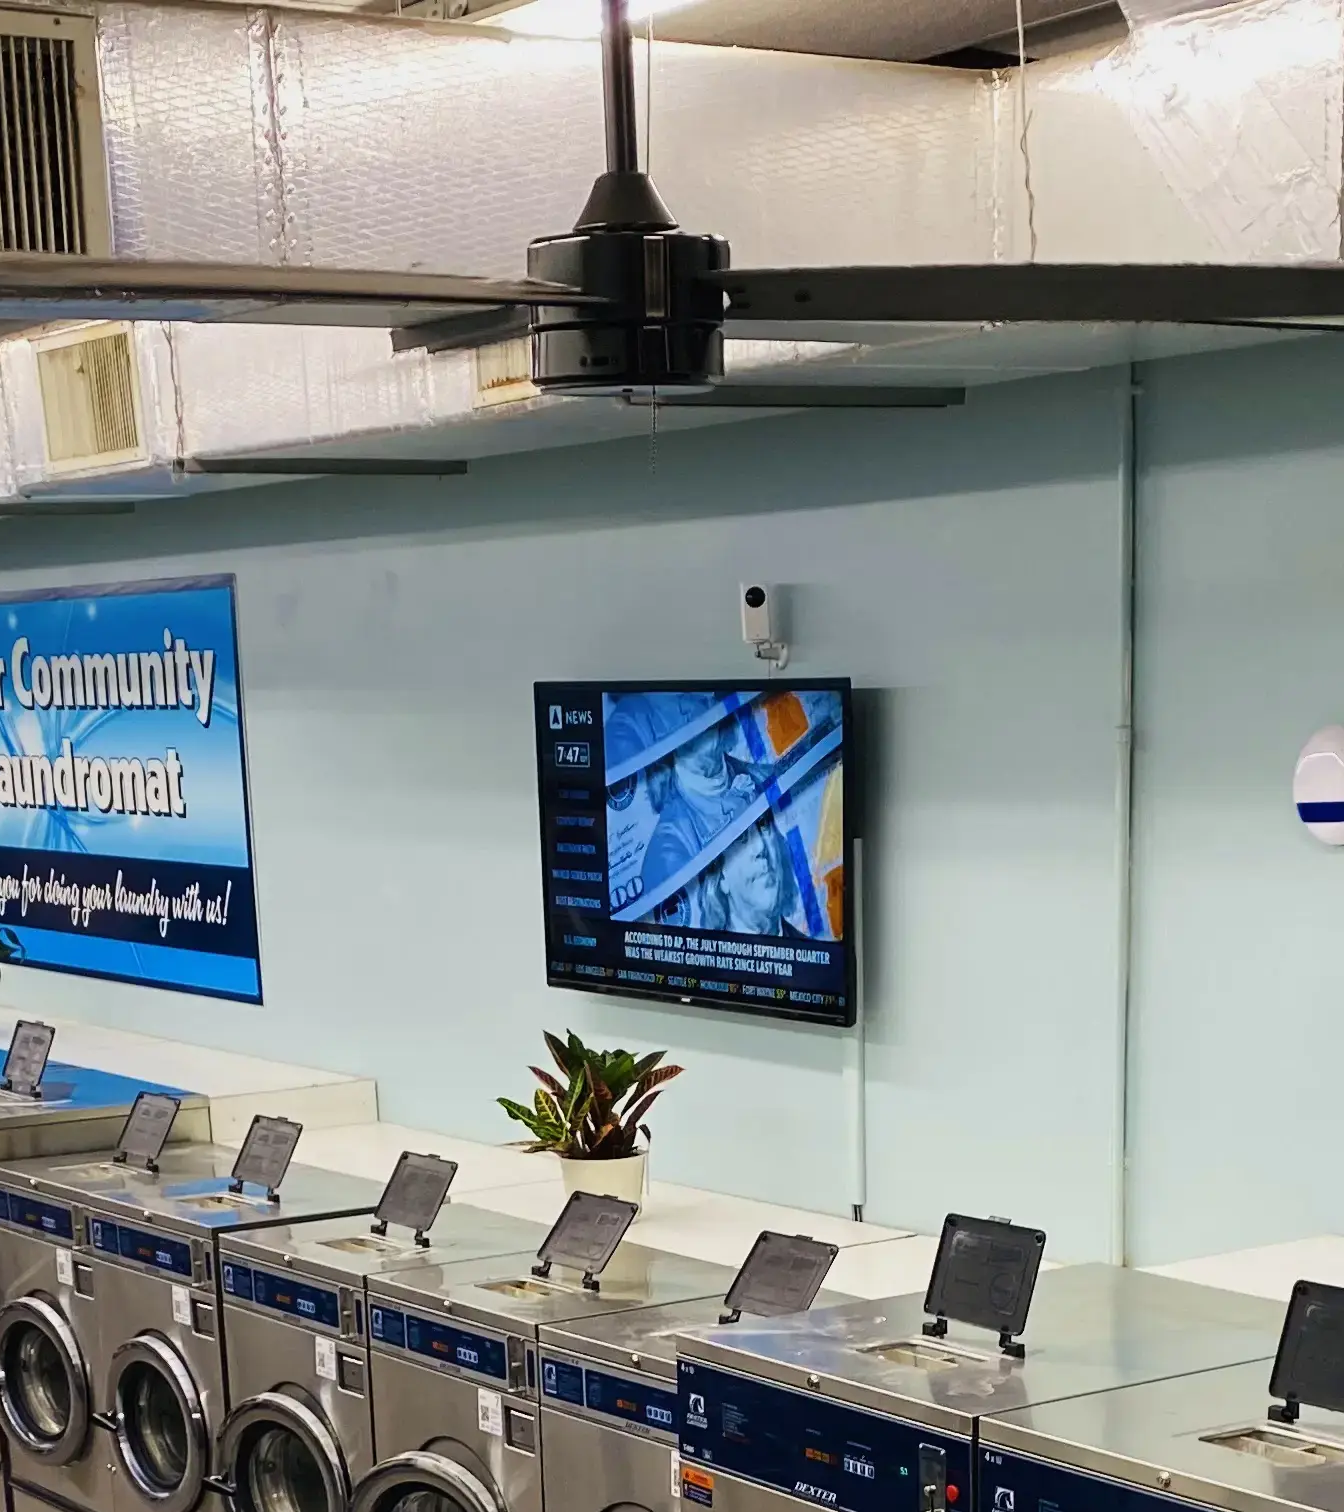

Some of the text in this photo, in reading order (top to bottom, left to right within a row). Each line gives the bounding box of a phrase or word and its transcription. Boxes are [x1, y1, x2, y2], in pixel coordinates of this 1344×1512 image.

[11, 627, 215, 727] Community
[565, 710, 593, 725] NEWS
[557, 746, 579, 763] 7:47
[20, 863, 43, 917] for
[43, 868, 80, 926] doing
[81, 881, 112, 928] your
[114, 869, 171, 938] laundry
[172, 881, 205, 922] with
[206, 880, 233, 926] us!
[624, 931, 831, 965] ACCORDING TO AP, THE JULY THROUGH SEPTEMBER QUARTER
[624, 946, 793, 977] WAS THE WEAKEST GROWTH RATE SINCE LAST YEAR
[794, 1480, 837, 1504] DEXTER
